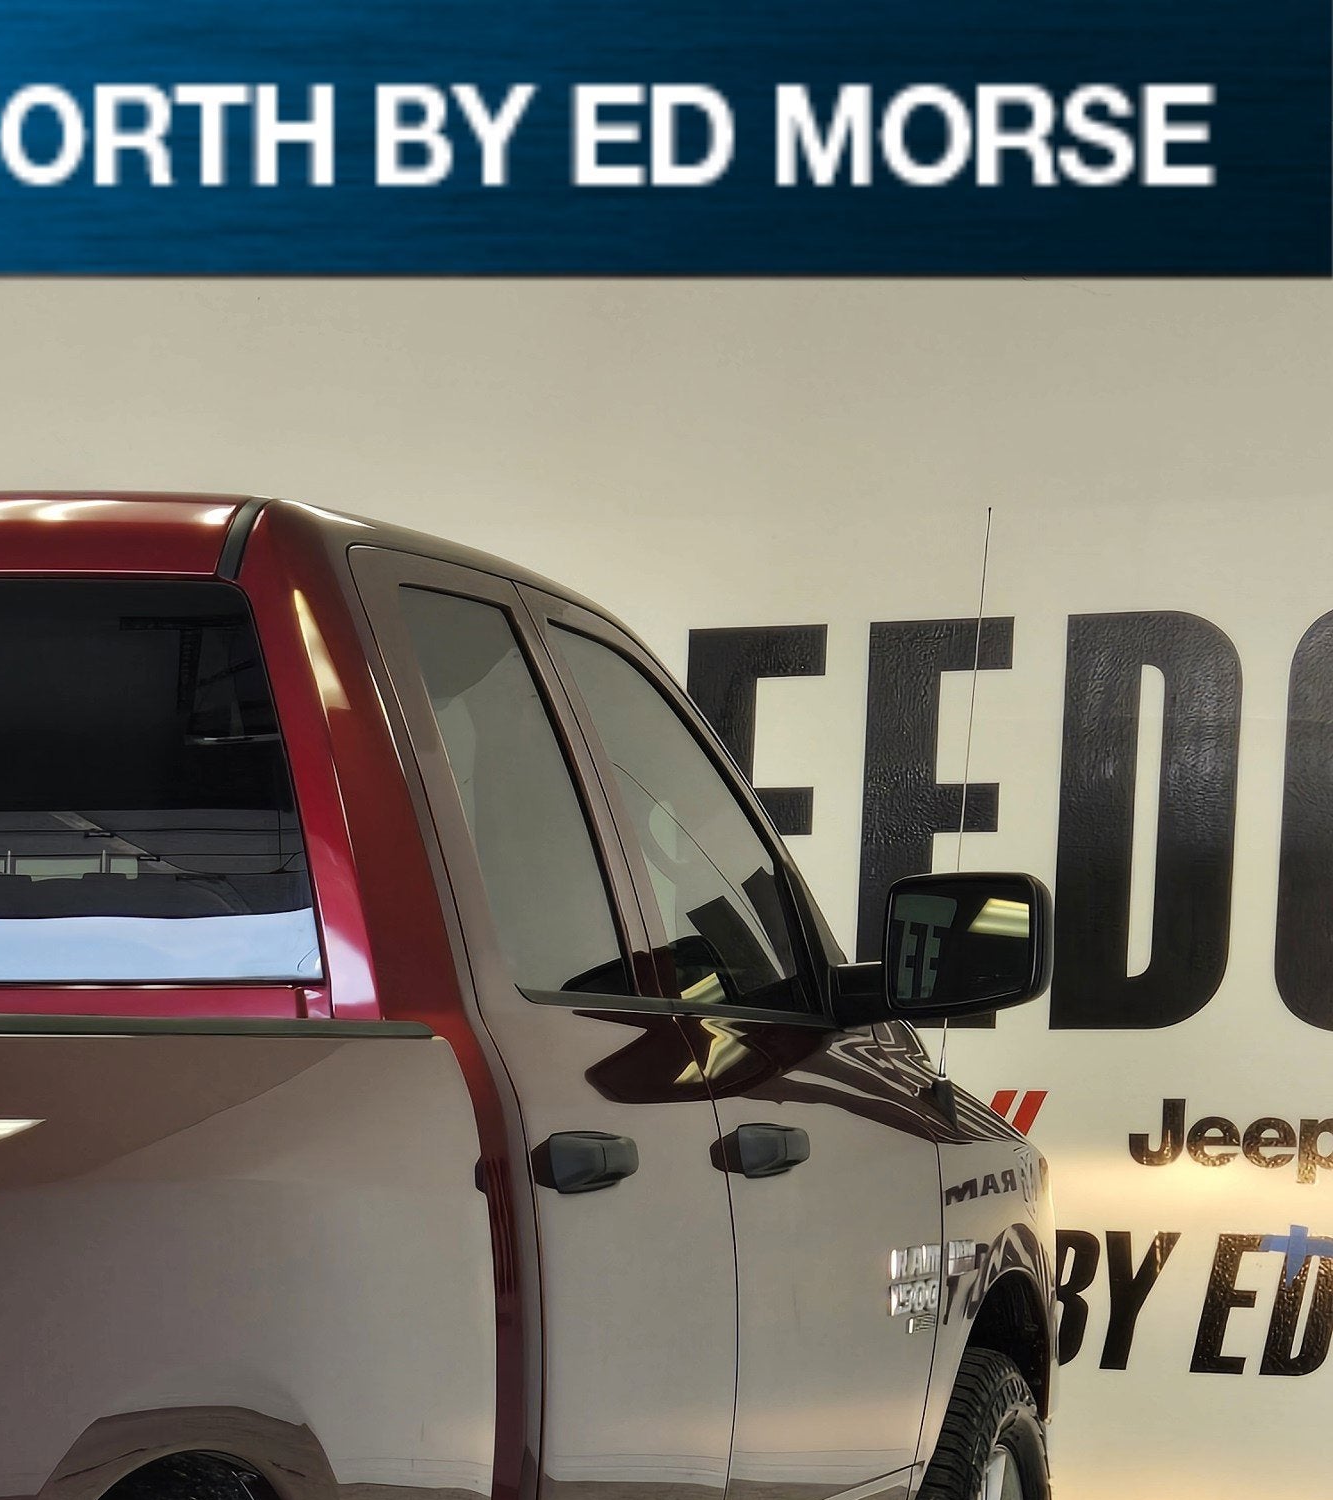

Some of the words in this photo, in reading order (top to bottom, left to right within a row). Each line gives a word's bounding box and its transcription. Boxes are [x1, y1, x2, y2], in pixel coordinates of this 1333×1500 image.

[1129, 1098, 1333, 1184] Jeep
[1055, 1229, 1182, 1370] BY
[1189, 1232, 1333, 1376] ED
